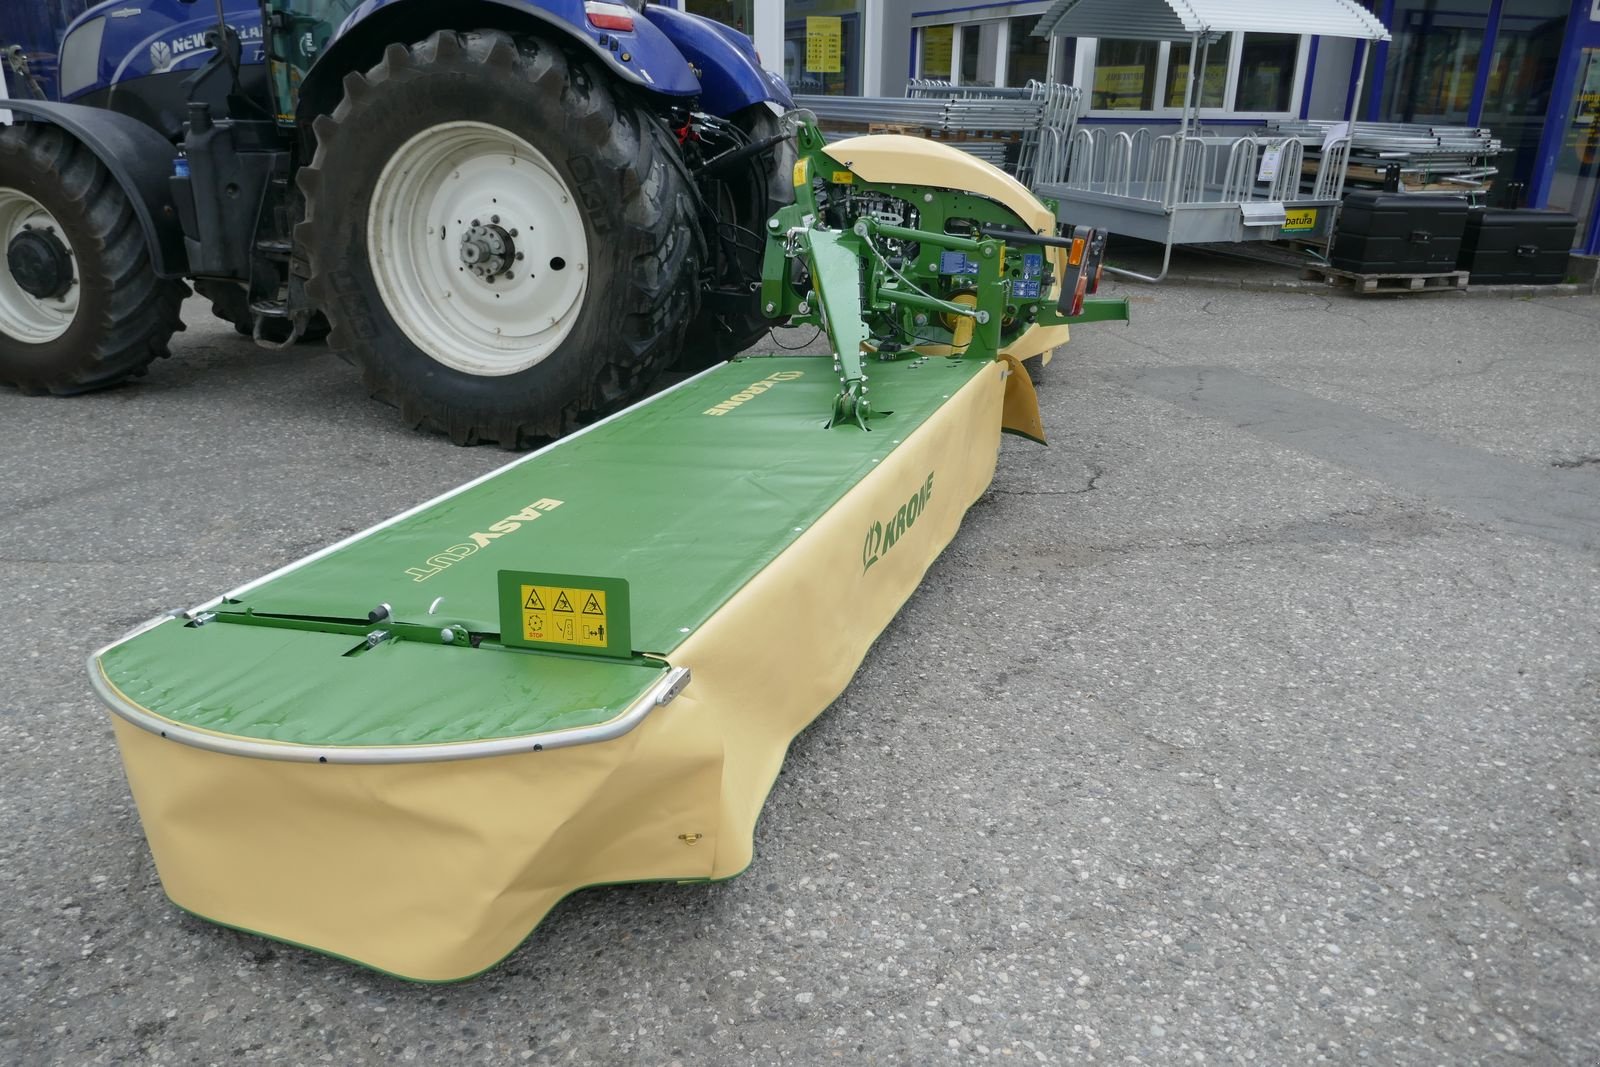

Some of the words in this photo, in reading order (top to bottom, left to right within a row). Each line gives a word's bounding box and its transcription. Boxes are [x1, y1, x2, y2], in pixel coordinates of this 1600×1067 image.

[172, 32, 206, 54] NEW
[1285, 217, 1312, 227] patura
[702, 380, 779, 416] KRONE
[881, 470, 934, 556] KRONE
